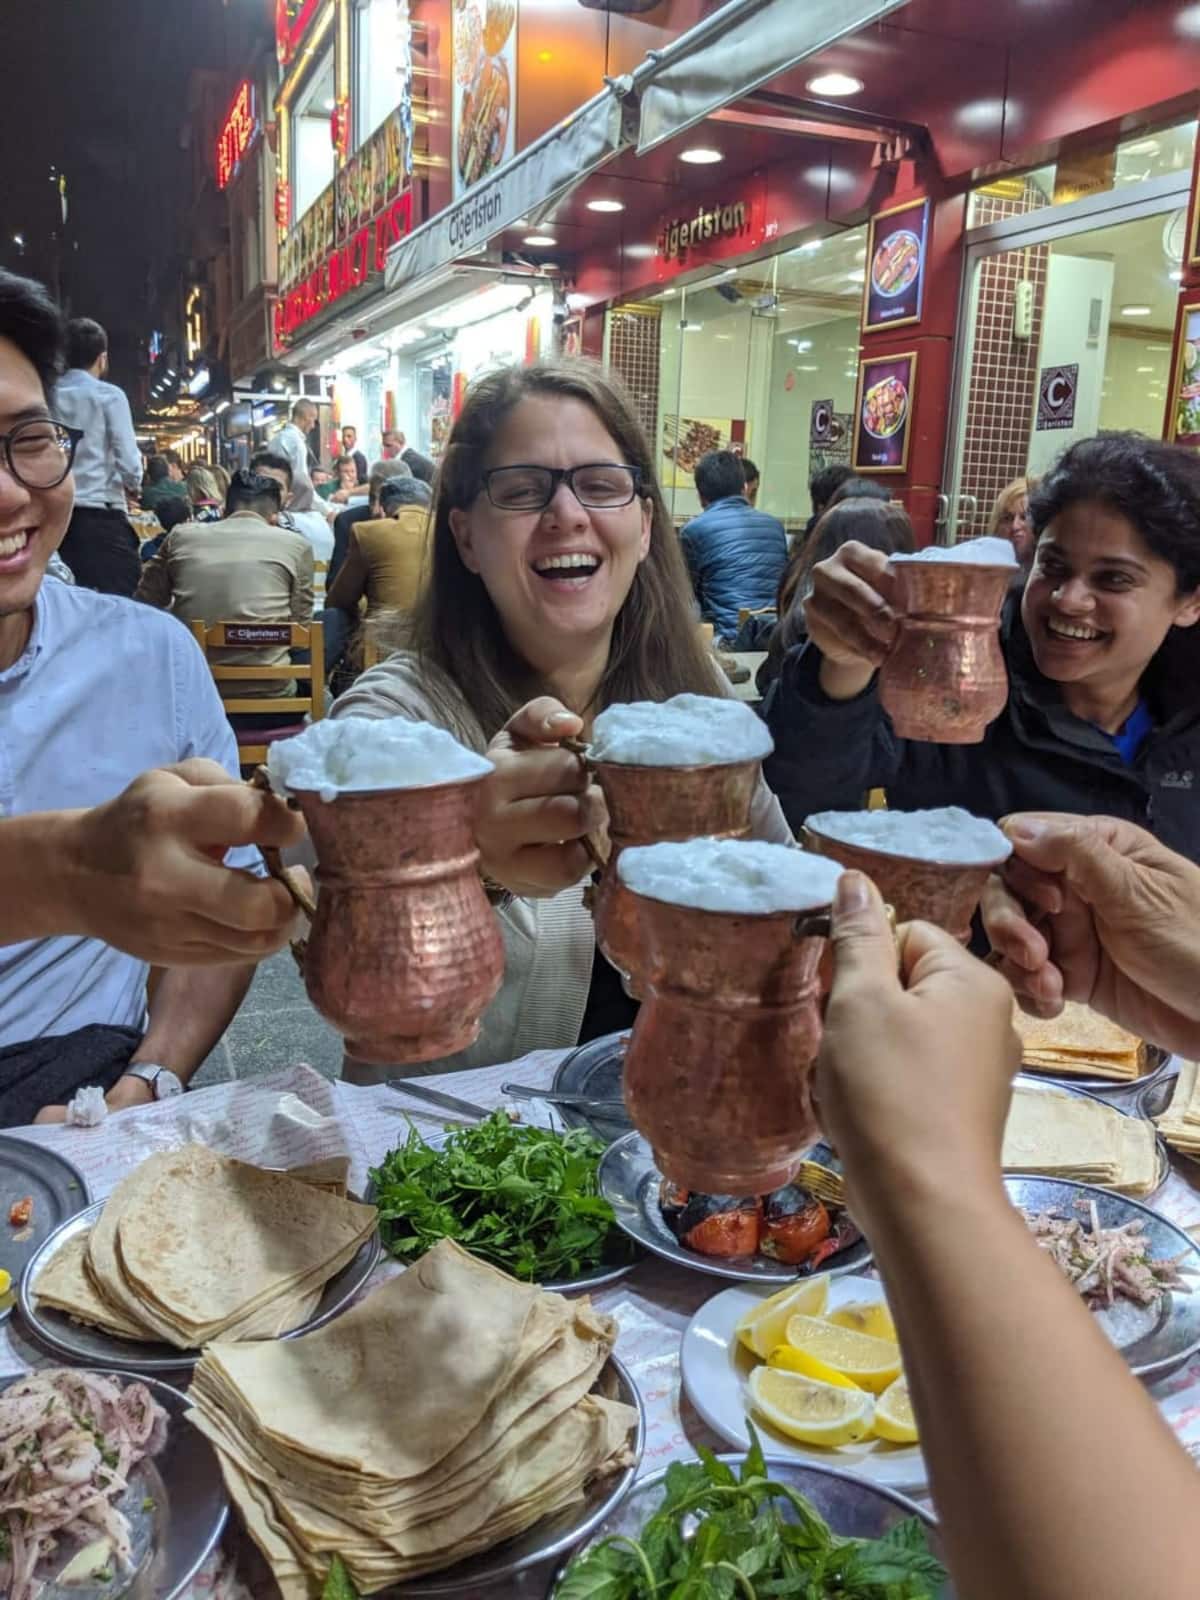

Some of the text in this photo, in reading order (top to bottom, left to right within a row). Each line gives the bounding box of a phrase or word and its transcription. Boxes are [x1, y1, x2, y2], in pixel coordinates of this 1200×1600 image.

[448, 191, 502, 249] Ciğeristan
[658, 200, 745, 258] iğeristan
[1047, 377, 1066, 408] C
[815, 408, 827, 432] C
